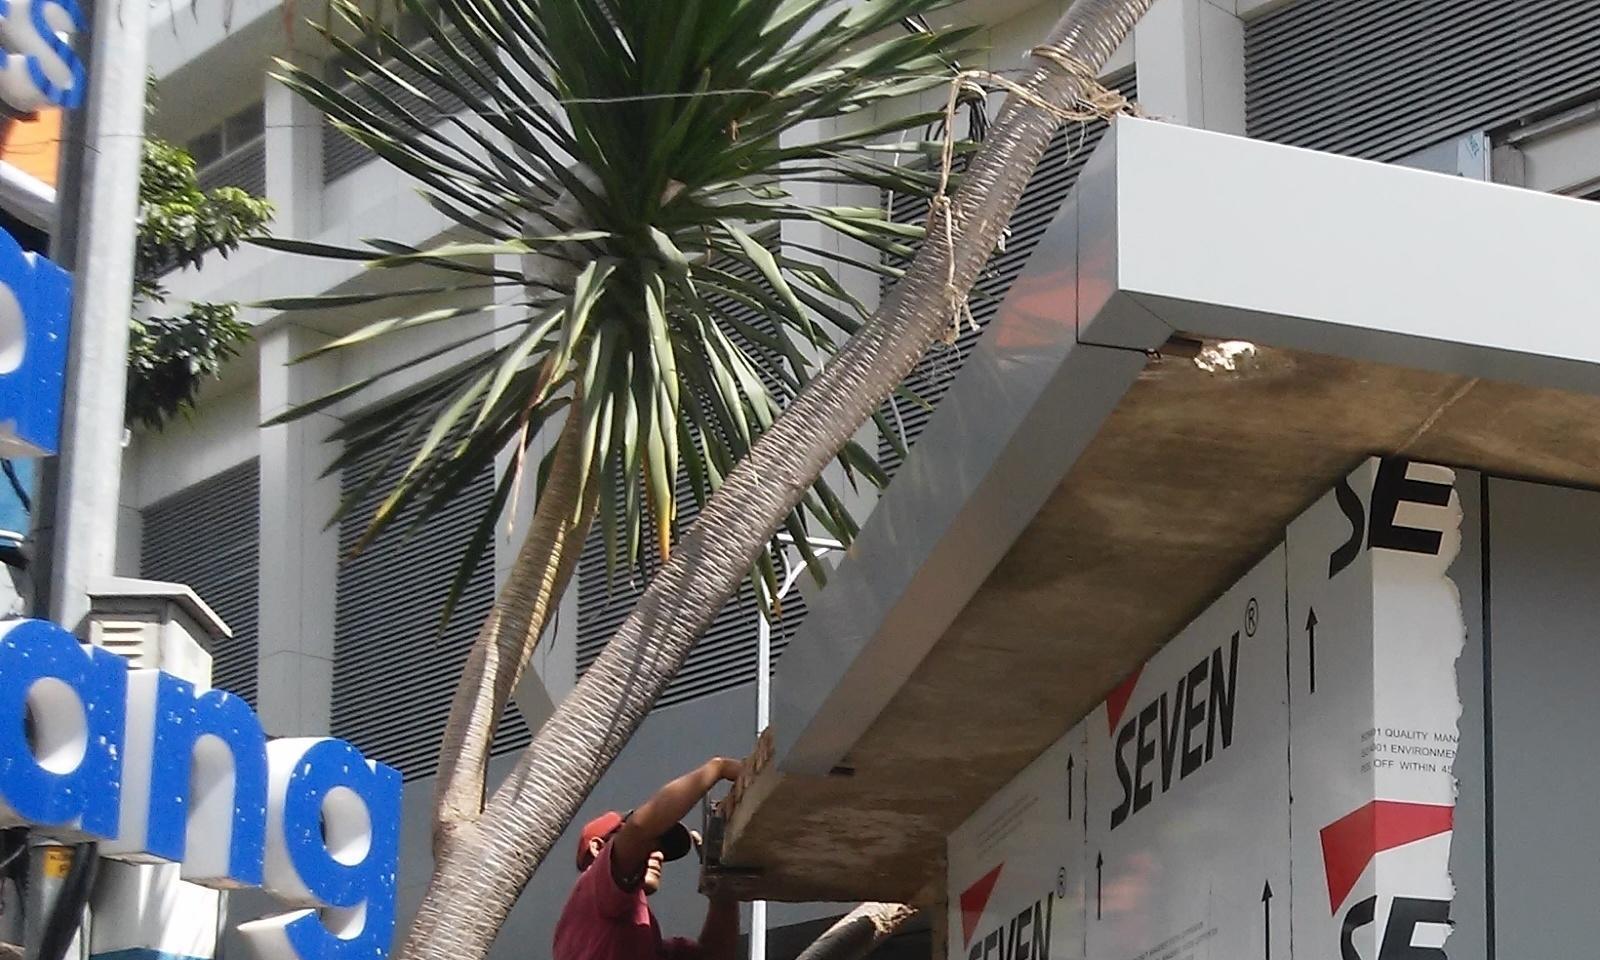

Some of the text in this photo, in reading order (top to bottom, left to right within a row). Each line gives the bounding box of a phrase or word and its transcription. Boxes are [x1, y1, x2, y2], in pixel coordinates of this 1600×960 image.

[1110, 630, 1240, 831] SEVEN
[1385, 728, 1428, 740] QUALITY
[1373, 759, 1394, 768] OFF
[1400, 761, 1436, 772] WITHIN
